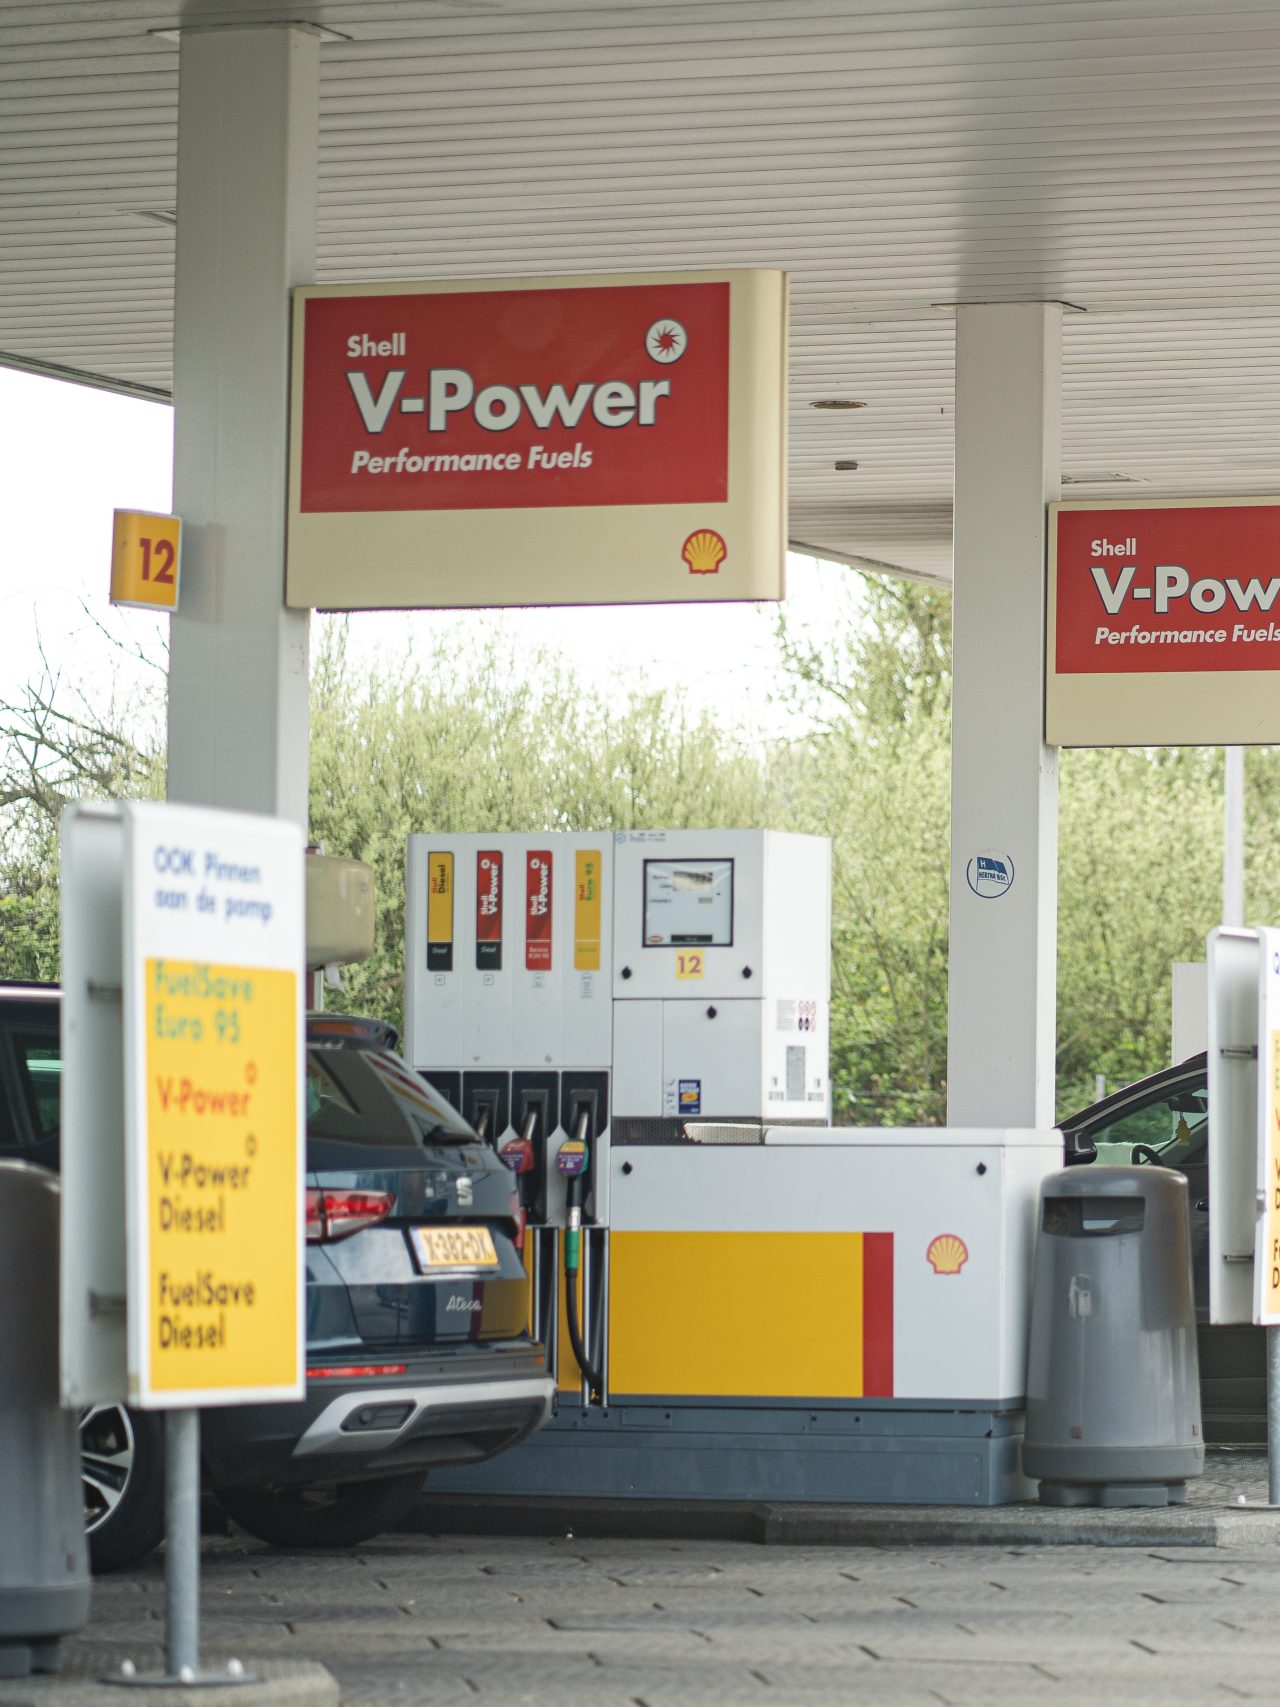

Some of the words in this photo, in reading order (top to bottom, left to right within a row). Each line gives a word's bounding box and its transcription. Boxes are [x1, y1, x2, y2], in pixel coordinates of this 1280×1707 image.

[346, 333, 406, 358] Shell
[345, 368, 671, 434] V-Power
[351, 446, 521, 474] Performance
[527, 443, 593, 470] Fuels
[139, 537, 174, 584] 12
[1091, 538, 1137, 557] Shell
[1095, 625, 1227, 645] Performance
[154, 845, 195, 876] OOK
[204, 852, 262, 885] Pinnen
[438, 864, 446, 894] Diesel
[155, 889, 188, 910] aan
[197, 885, 216, 913] de
[225, 898, 273, 927] pomp
[488, 862, 499, 915] V-Power
[537, 862, 549, 915] V-Power
[155, 960, 254, 1002] FuelSave
[678, 956, 701, 974] 12
[155, 1004, 203, 1040] Euro
[216, 1008, 240, 1044] 95
[156, 1074, 251, 1116] V-Power
[157, 1151, 251, 1190] V-Power
[158, 1194, 225, 1234] Diesel
[158, 1269, 255, 1309] FuelSave
[446, 1296, 482, 1311] Ateca
[158, 1313, 226, 1350] Diesel
